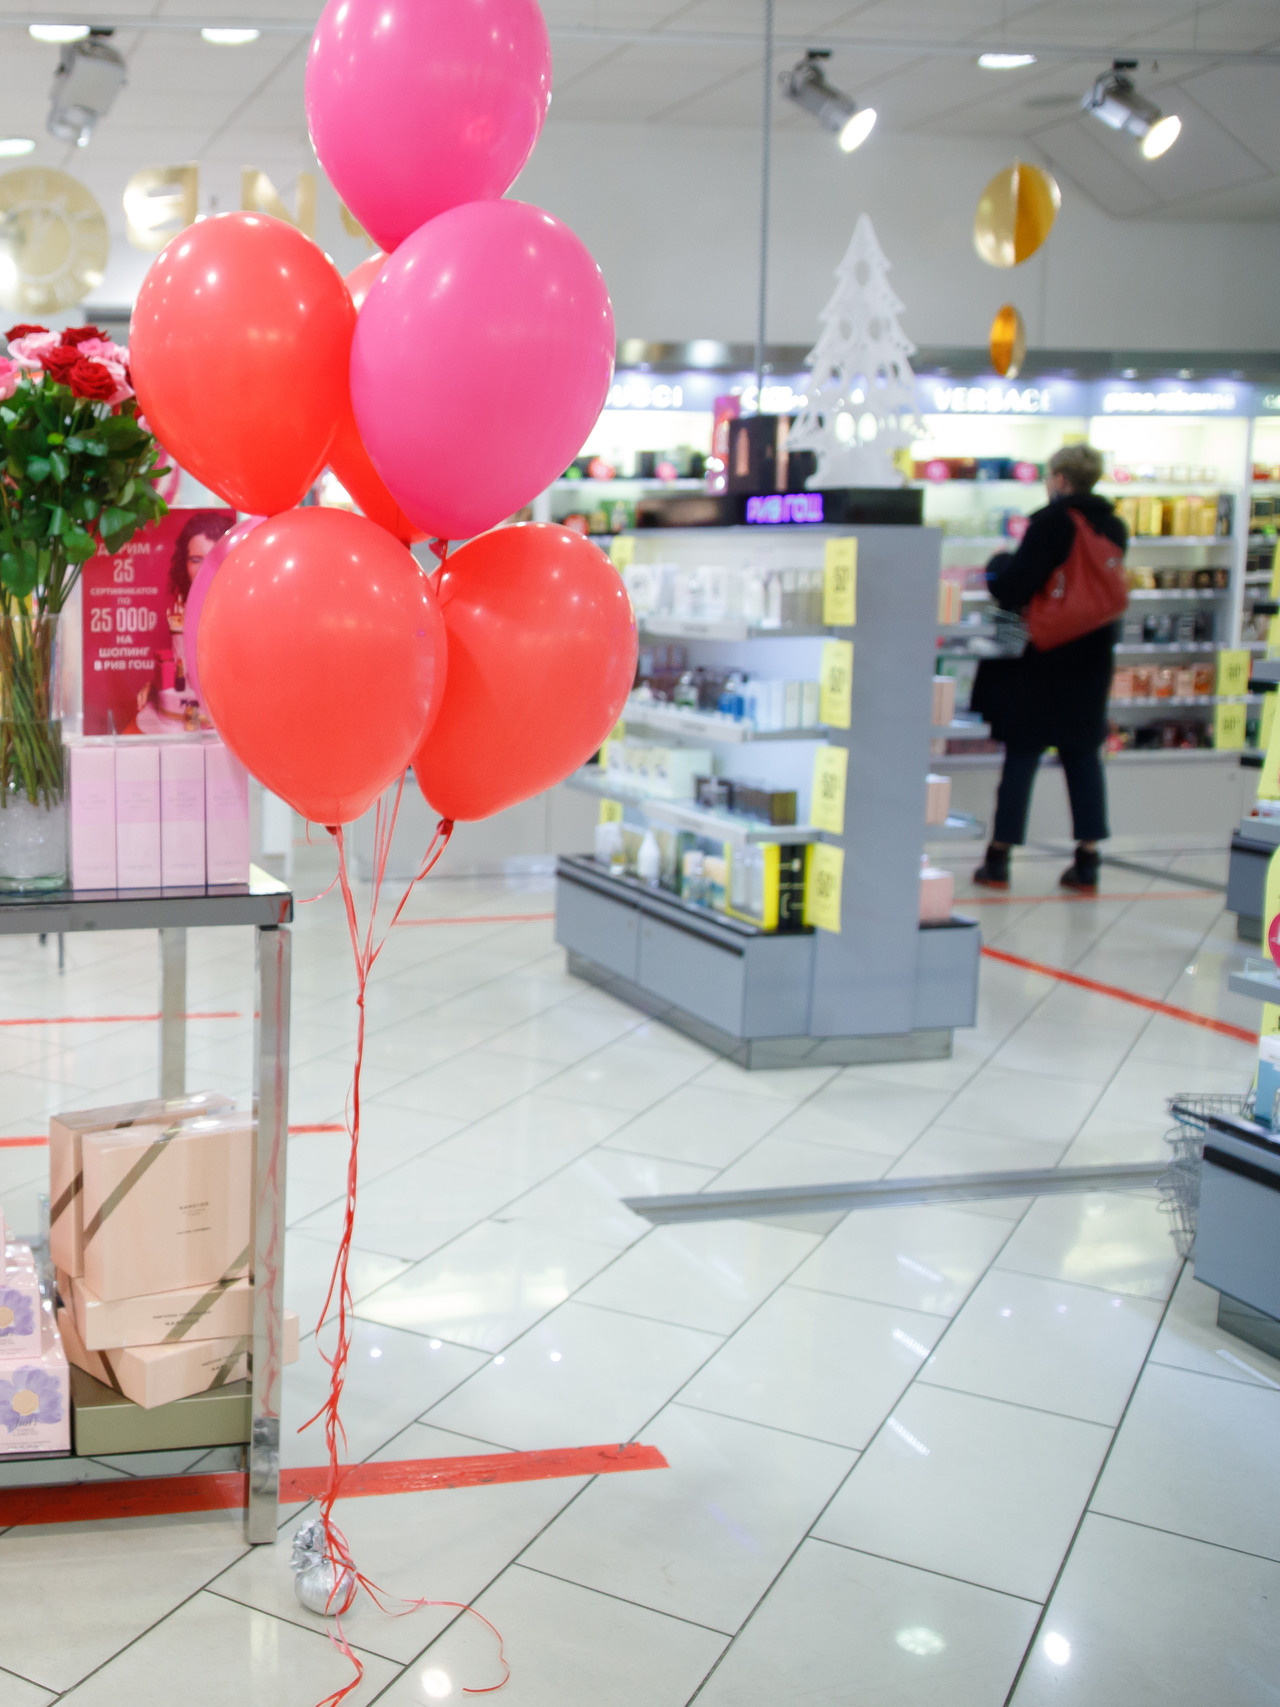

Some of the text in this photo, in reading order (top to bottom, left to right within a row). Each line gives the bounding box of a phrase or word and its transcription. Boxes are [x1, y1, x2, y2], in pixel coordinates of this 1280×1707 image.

[113, 558, 135, 583] 25
[90, 587, 158, 596] СЕРТИФИКАТОВ
[90, 607, 113, 633] 25
[116, 635, 133, 645] НА
[98, 646, 150, 658] ШОПИНГ
[94, 659, 155, 671] В РИВ ГОШ
